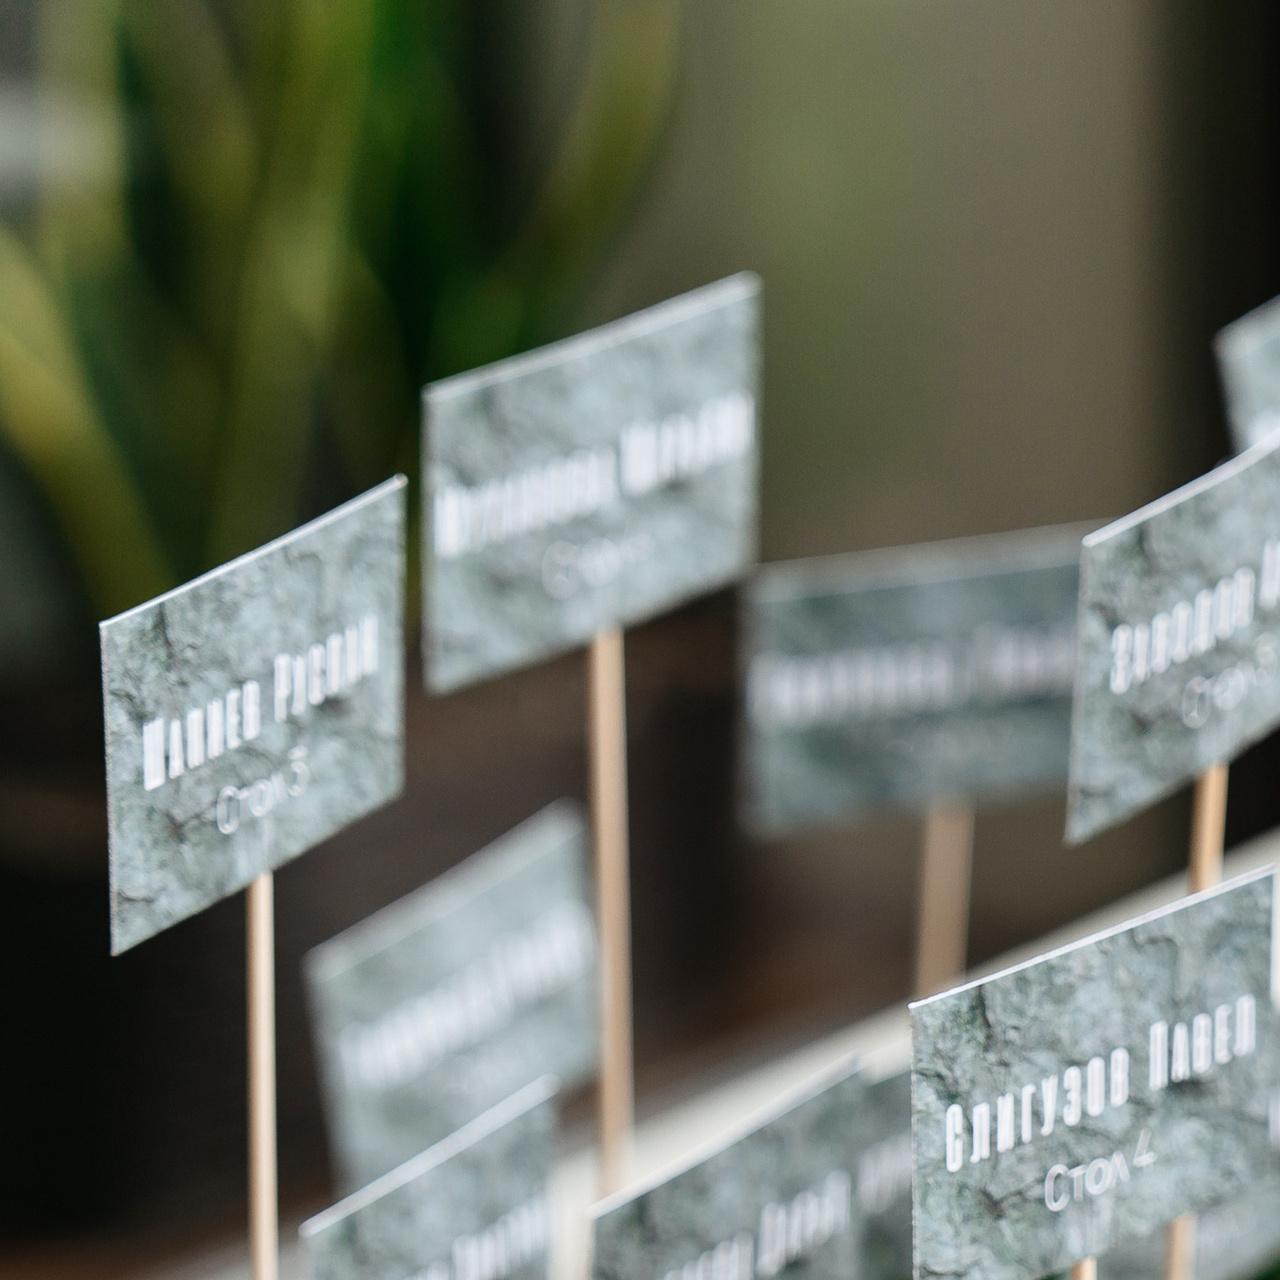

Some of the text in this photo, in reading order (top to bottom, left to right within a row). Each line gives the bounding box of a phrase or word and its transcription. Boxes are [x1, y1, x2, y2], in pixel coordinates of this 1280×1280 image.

[945, 1047, 1130, 1173] СЛИГУЗОВ
[1148, 993, 1257, 1092] ПАВЕЛ
[1134, 1128, 1156, 1169] 4
